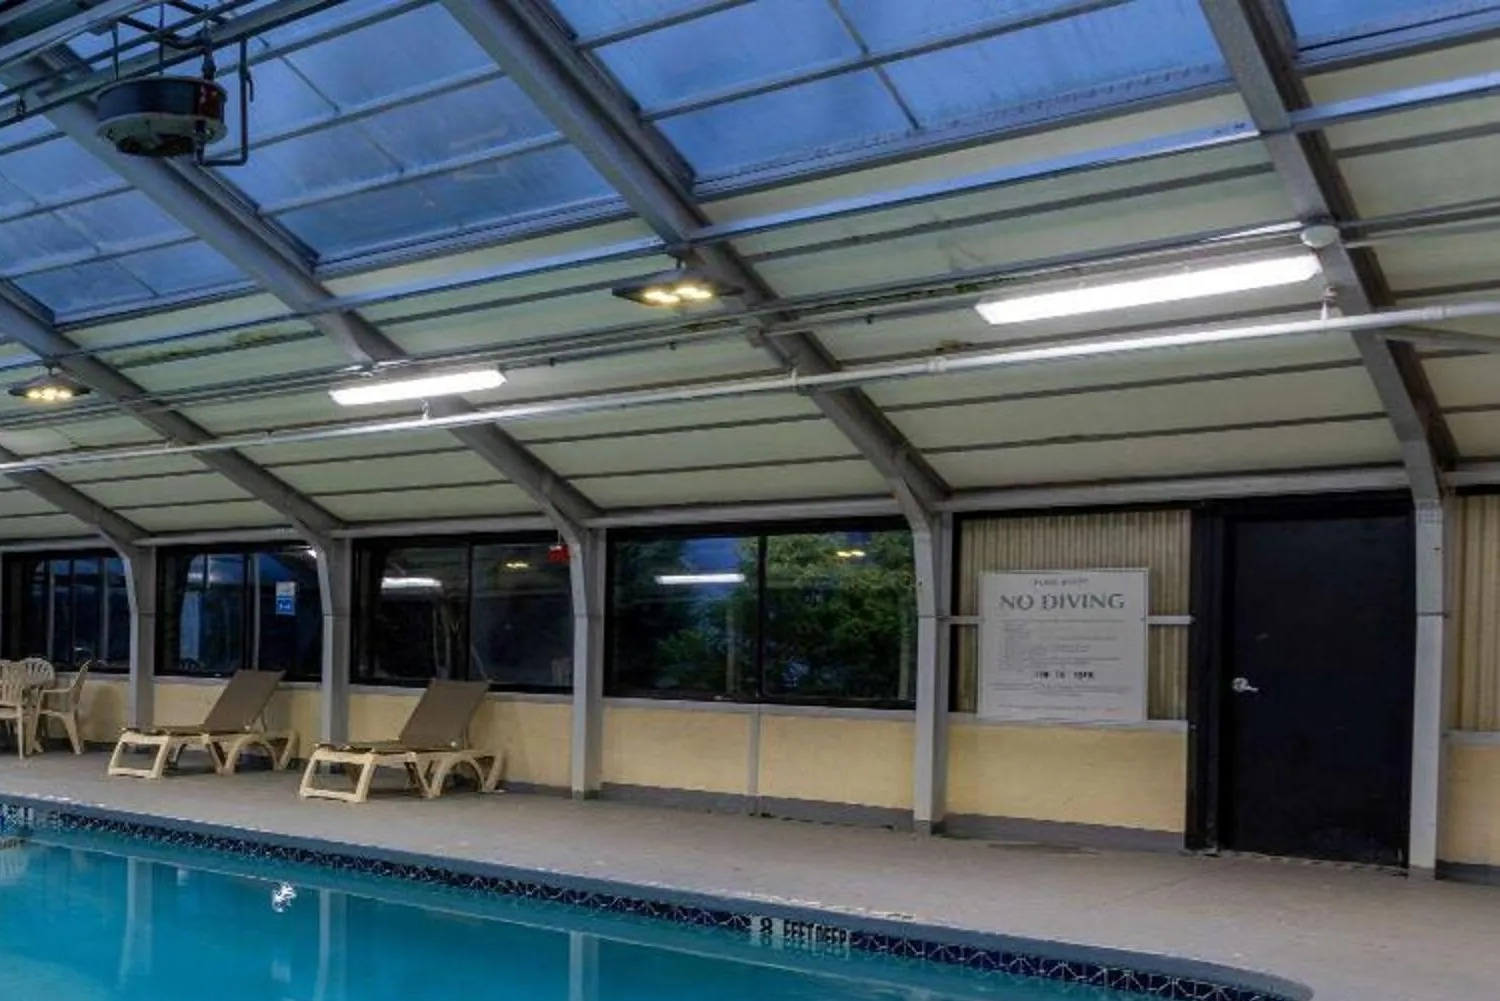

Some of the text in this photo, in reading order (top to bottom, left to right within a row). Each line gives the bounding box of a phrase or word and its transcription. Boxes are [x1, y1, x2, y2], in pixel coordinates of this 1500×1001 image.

[1000, 592, 1125, 610] NO DIVING
[760, 917, 773, 934] 8
